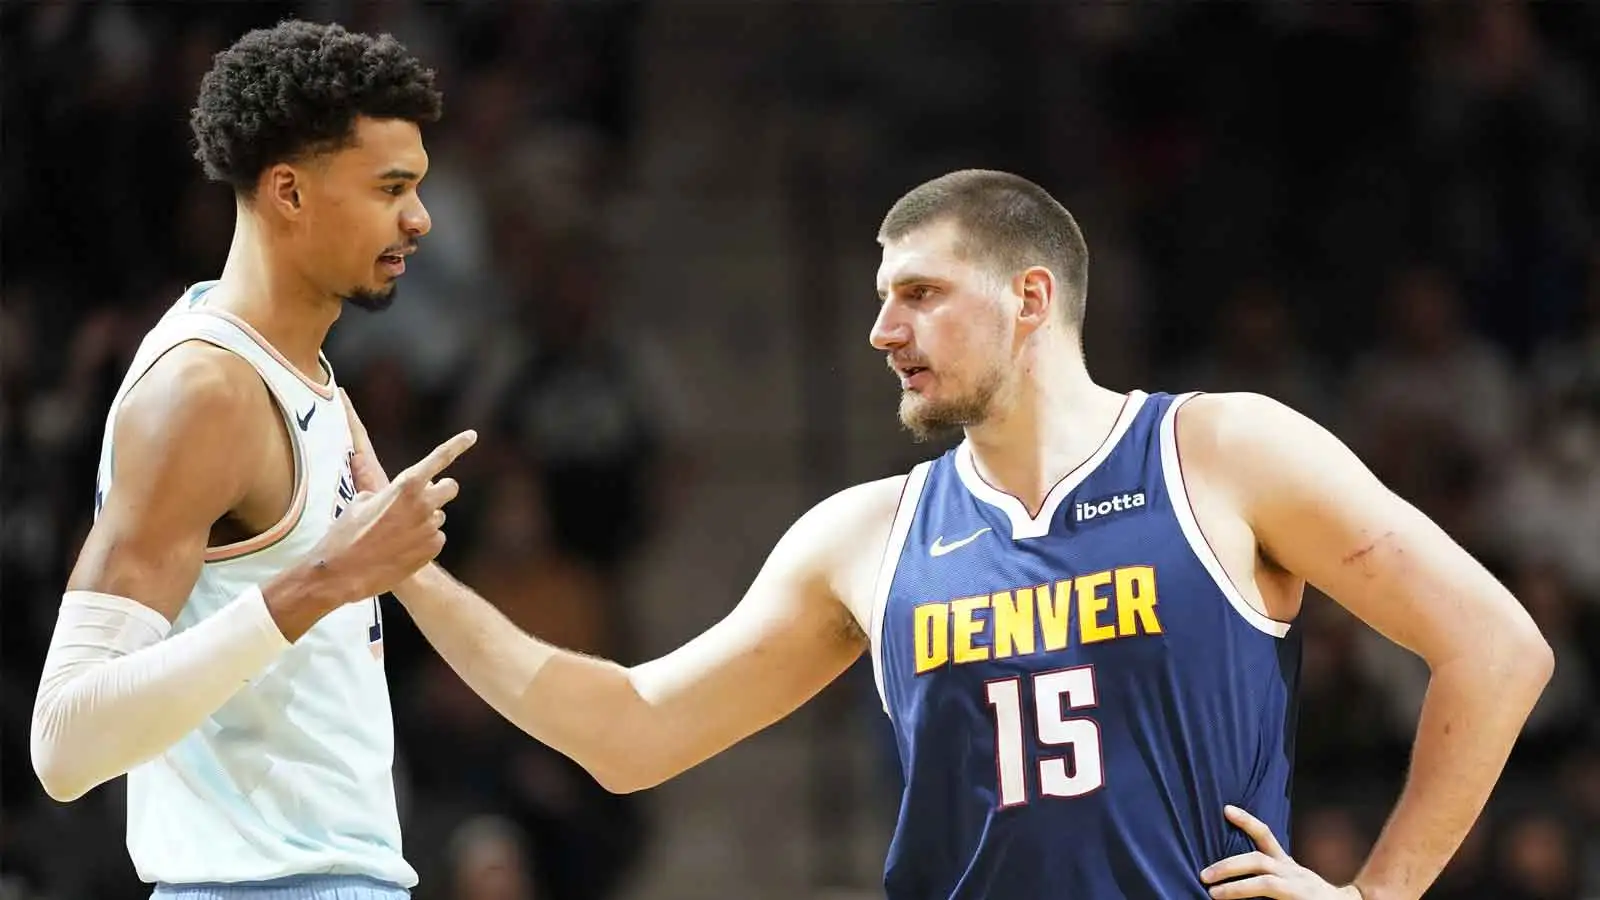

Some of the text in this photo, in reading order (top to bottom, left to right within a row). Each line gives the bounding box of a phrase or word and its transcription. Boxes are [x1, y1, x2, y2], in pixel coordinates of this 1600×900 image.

[1076, 493, 1145, 521] ibotta
[914, 565, 1163, 675] DENVER
[984, 664, 1105, 809] 15
